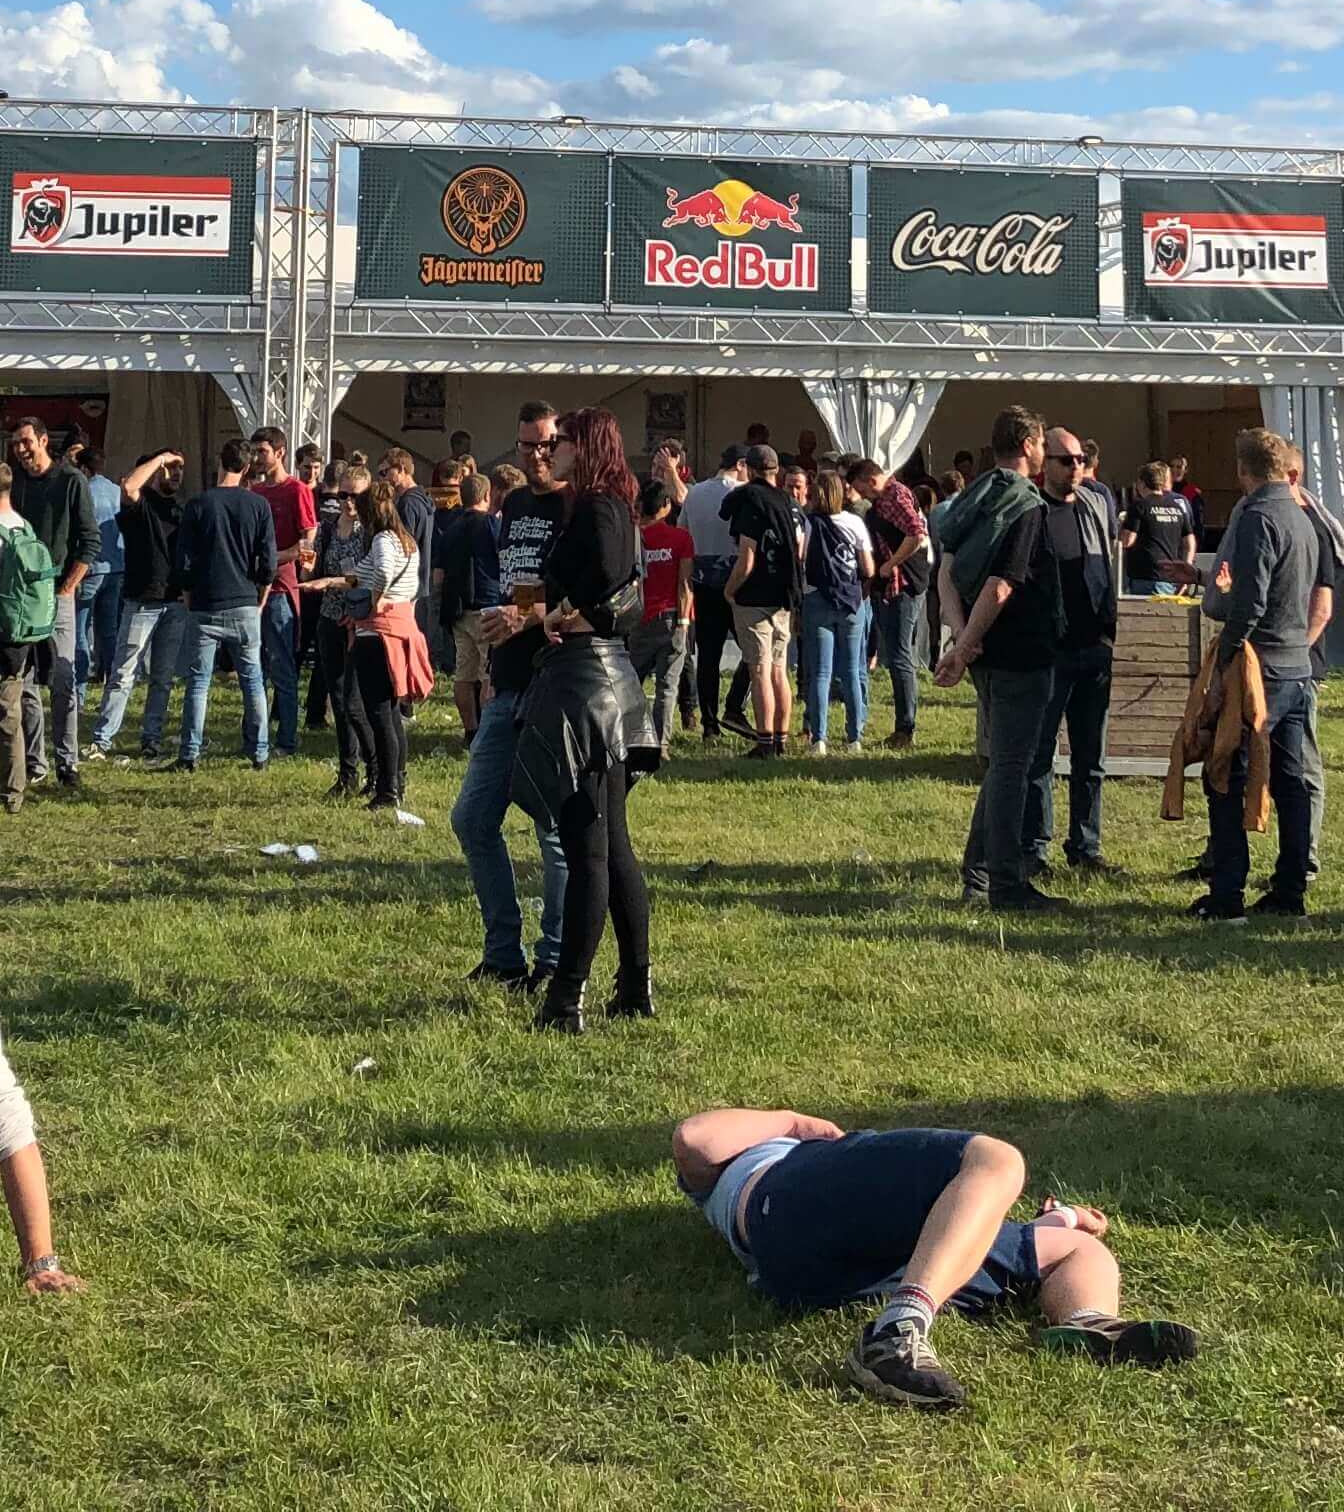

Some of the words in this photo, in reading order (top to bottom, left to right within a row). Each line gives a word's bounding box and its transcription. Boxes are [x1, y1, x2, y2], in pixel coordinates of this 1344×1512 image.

[77, 204, 218, 244] Jupiler
[892, 209, 1074, 275] Coca-Cola
[1195, 241, 1317, 277] Jupiler
